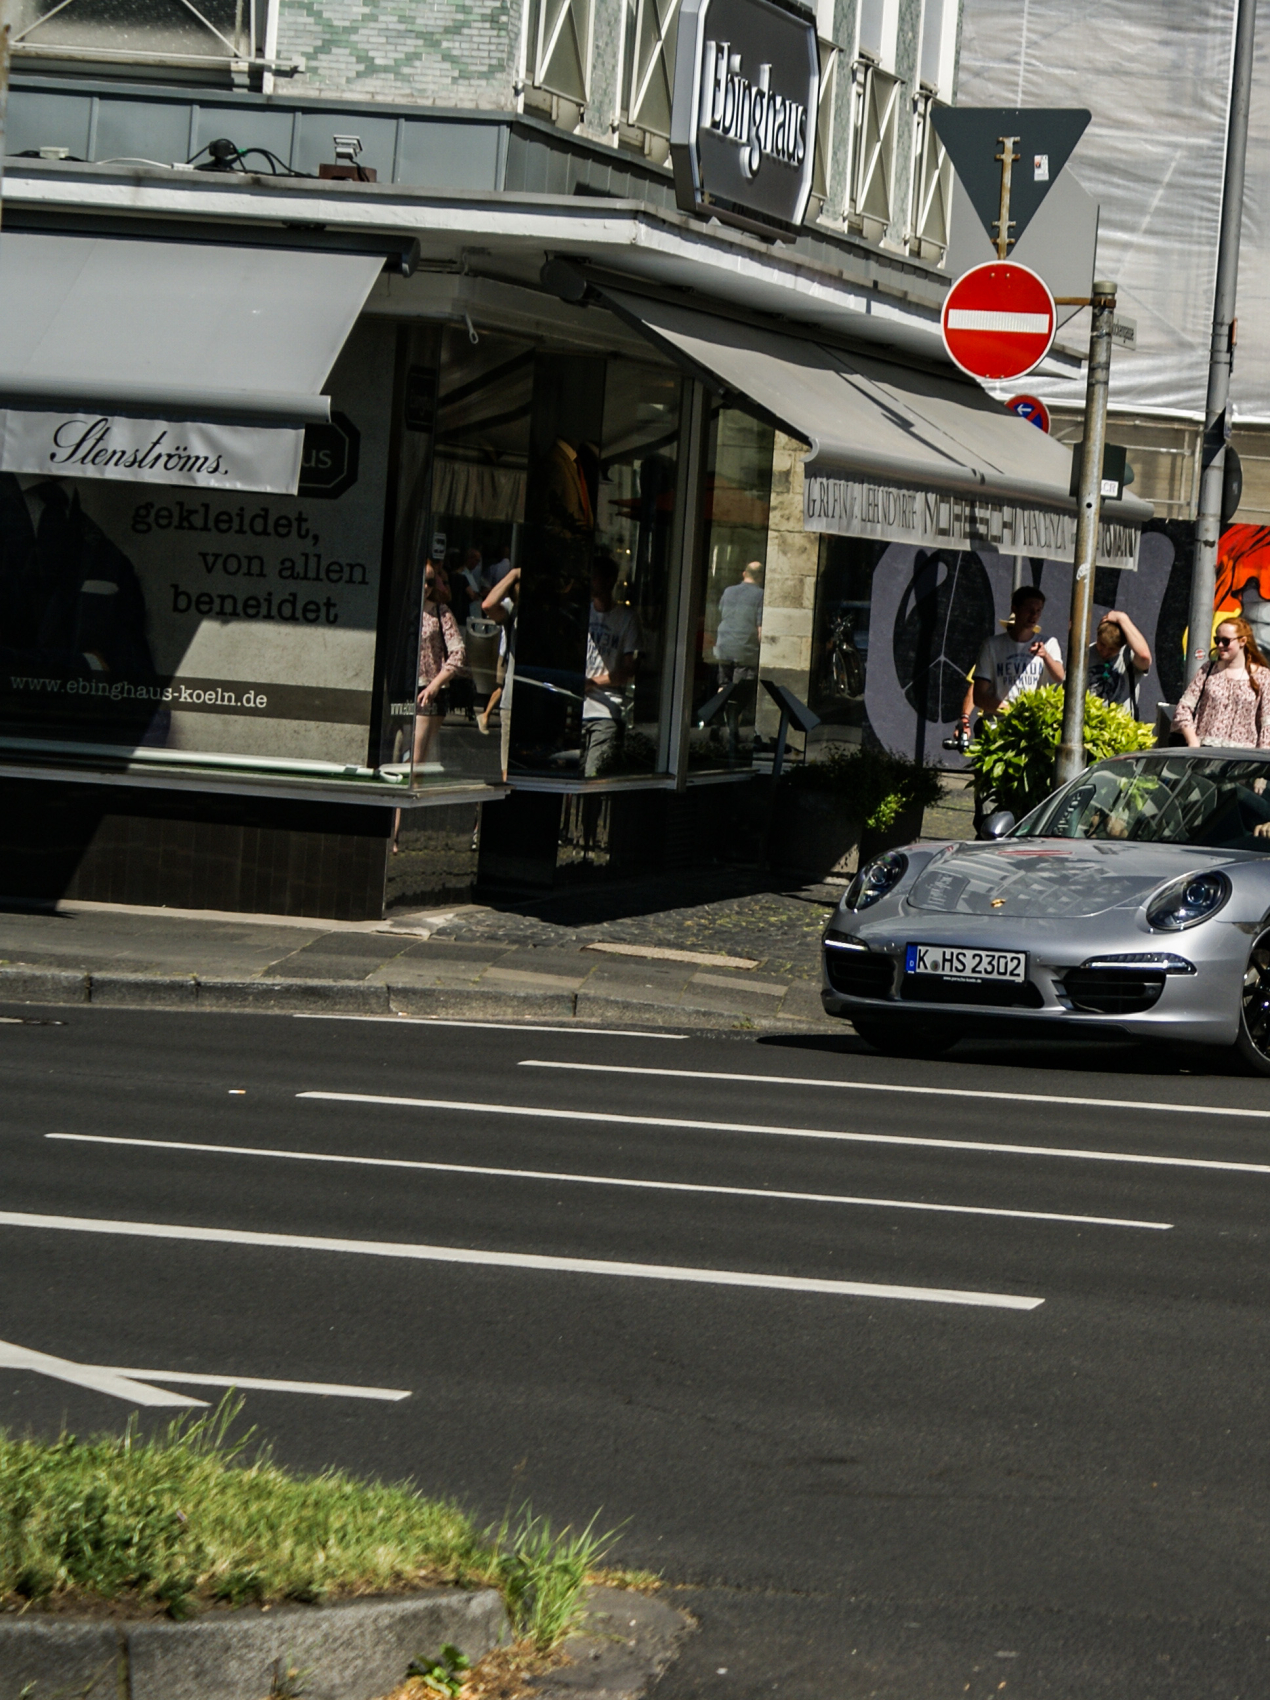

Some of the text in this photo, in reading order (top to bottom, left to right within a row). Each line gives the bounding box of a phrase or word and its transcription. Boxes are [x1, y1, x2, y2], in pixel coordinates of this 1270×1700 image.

[700, 40, 807, 178] Ebinghaus
[131, 501, 320, 546] gekleidet,
[198, 551, 369, 585] von allen
[170, 583, 339, 625] beneidet
[11, 674, 267, 708] www.ebinghaus-koeln.de
[917, 949, 1021, 977] K HS 2302
